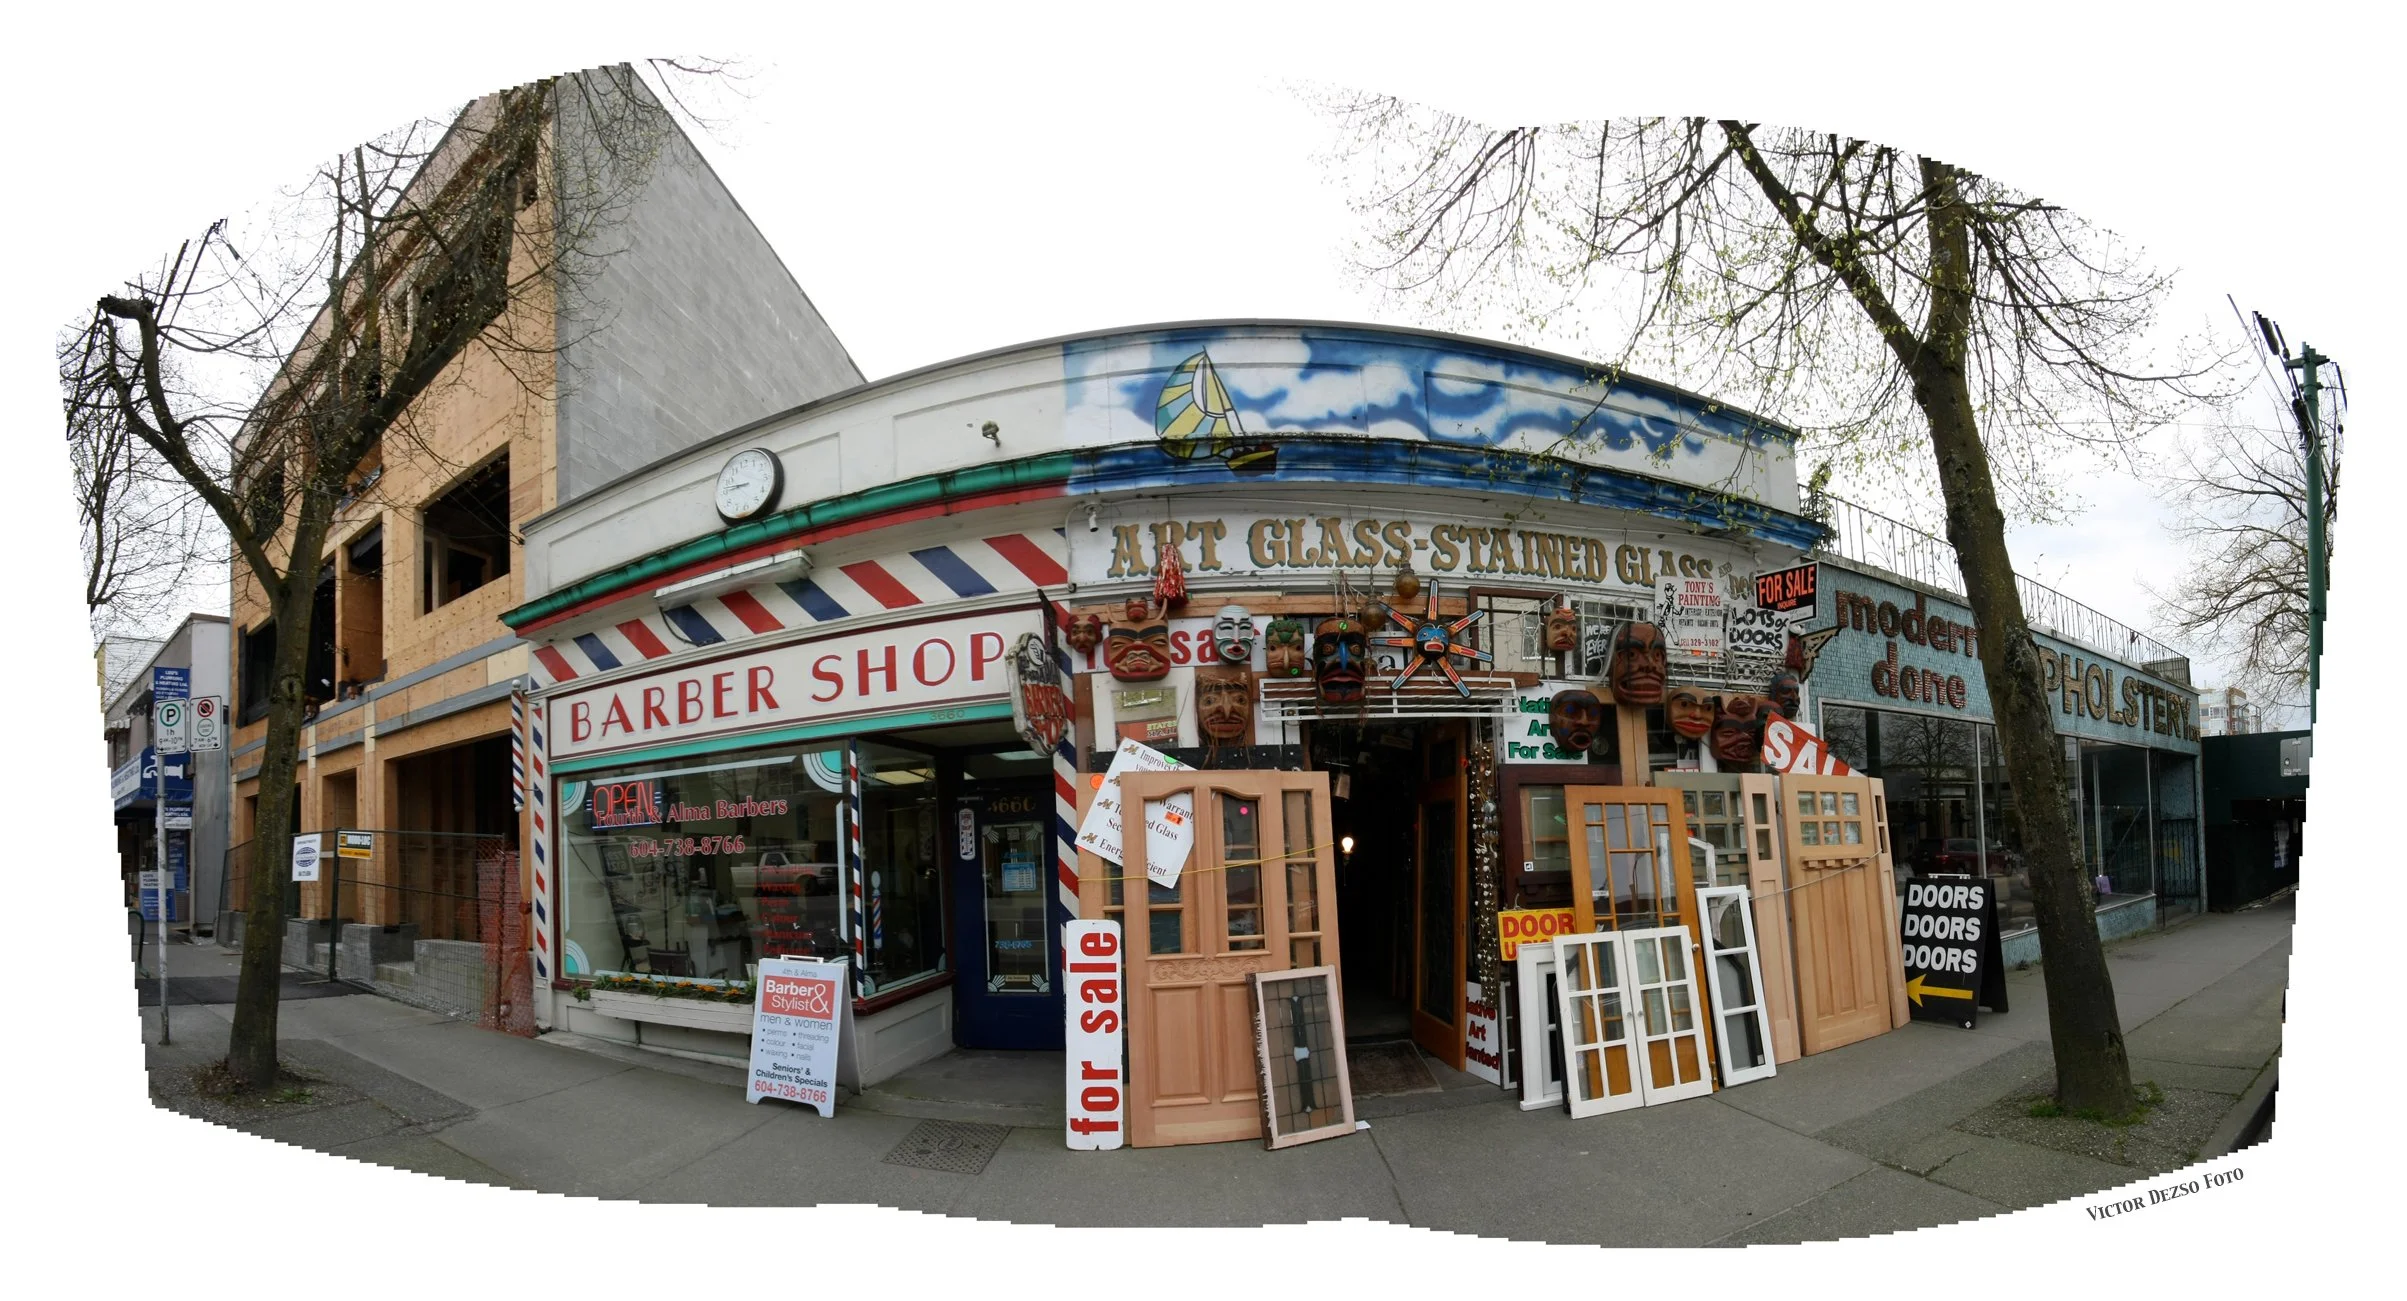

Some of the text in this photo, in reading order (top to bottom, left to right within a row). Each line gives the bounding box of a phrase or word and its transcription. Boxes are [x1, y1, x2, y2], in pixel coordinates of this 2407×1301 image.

[1107, 517, 1713, 588] ART GLASS-STAINED GLASS
[1684, 581, 1714, 593] TONY'S
[1758, 566, 1815, 606] FOR SALE
[1678, 594, 1721, 607] PAINTING
[1777, 598, 1798, 610] INQUIRE
[1731, 607, 1775, 628] LOTS
[1729, 627, 1783, 650] DOORS
[570, 665, 780, 743] BARBER
[811, 631, 1006, 703] SHOP
[1871, 642, 1967, 709] done
[2037, 644, 2190, 740] PHOLSTERY
[166, 708, 176, 722] P
[1527, 720, 1550, 736] Ar
[1140, 750, 1172, 771] Improves
[1508, 742, 1539, 759] For
[593, 781, 654, 819] OPEN
[596, 796, 788, 828] Fourth & Alma Barbers
[1156, 822, 1178, 841] Glass
[630, 834, 746, 858] 604-738-8766
[1907, 884, 1985, 910] DOORS
[1502, 912, 1576, 938] DOOR
[1904, 914, 1981, 941] DOORS
[1902, 944, 1978, 974] DOORS
[782, 968, 818, 978] 4th & Alma
[1069, 932, 1118, 1034] sale
[765, 979, 830, 1014] Barber &
[771, 994, 811, 1012] Stylist
[1466, 996, 1497, 1021] ative
[760, 1013, 833, 1031] men & women
[1468, 1020, 1487, 1041] Art
[766, 1038, 815, 1051] colour facial
[767, 1029, 830, 1043] perms threading
[765, 1049, 788, 1059] waxing
[1466, 1041, 1501, 1070] anted
[755, 1068, 829, 1088] Children's Specials
[772, 1062, 811, 1076] Seniors' &
[754, 1080, 828, 1103] 604-738-8766
[1070, 1060, 1119, 1135] for
